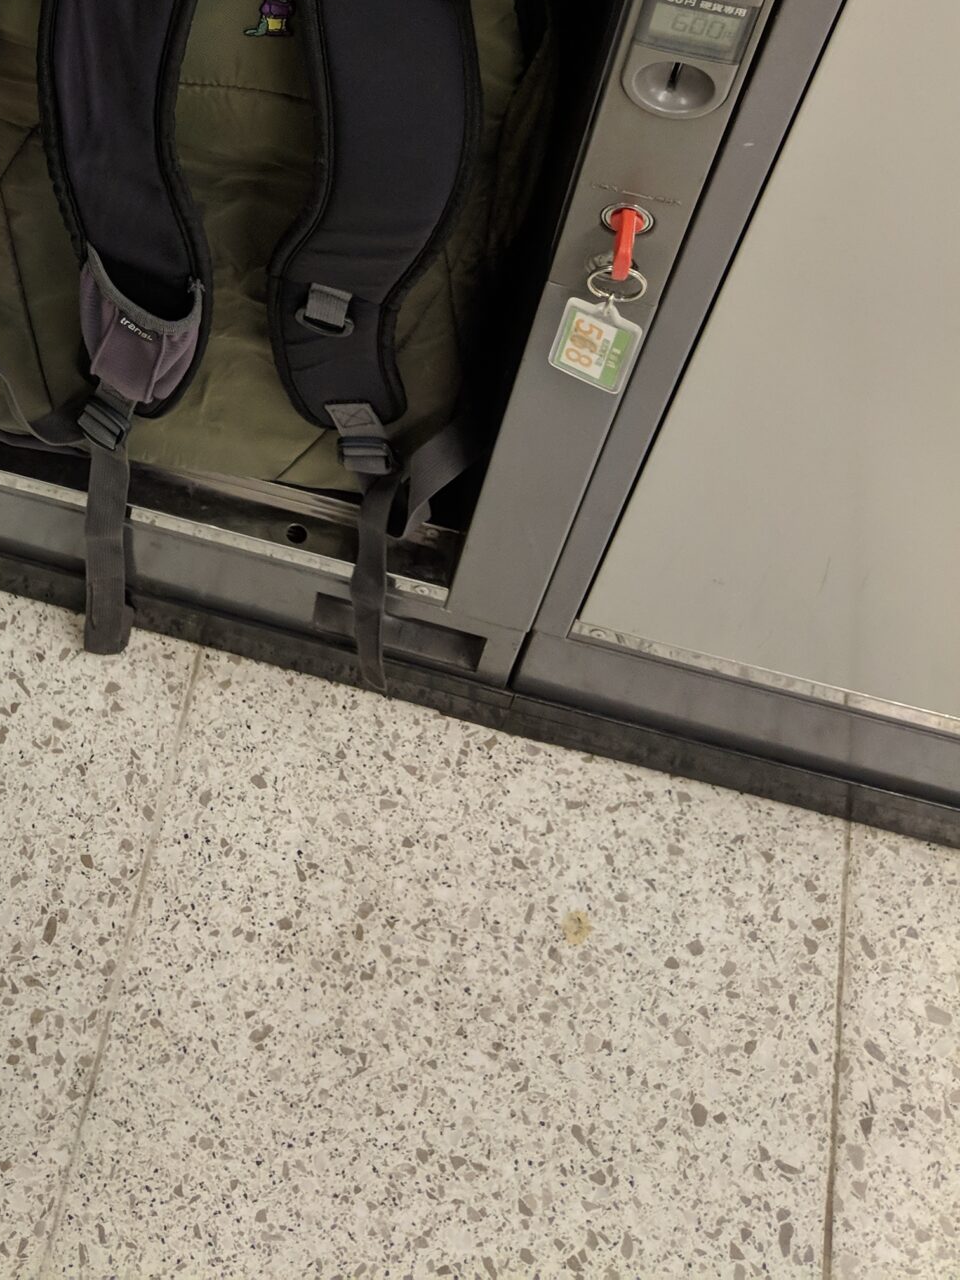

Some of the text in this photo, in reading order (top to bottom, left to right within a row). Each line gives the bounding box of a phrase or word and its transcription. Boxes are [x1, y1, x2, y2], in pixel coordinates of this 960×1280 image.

[699, 0, 748, 17] 硬貨専用
[565, 318, 604, 369] 568
